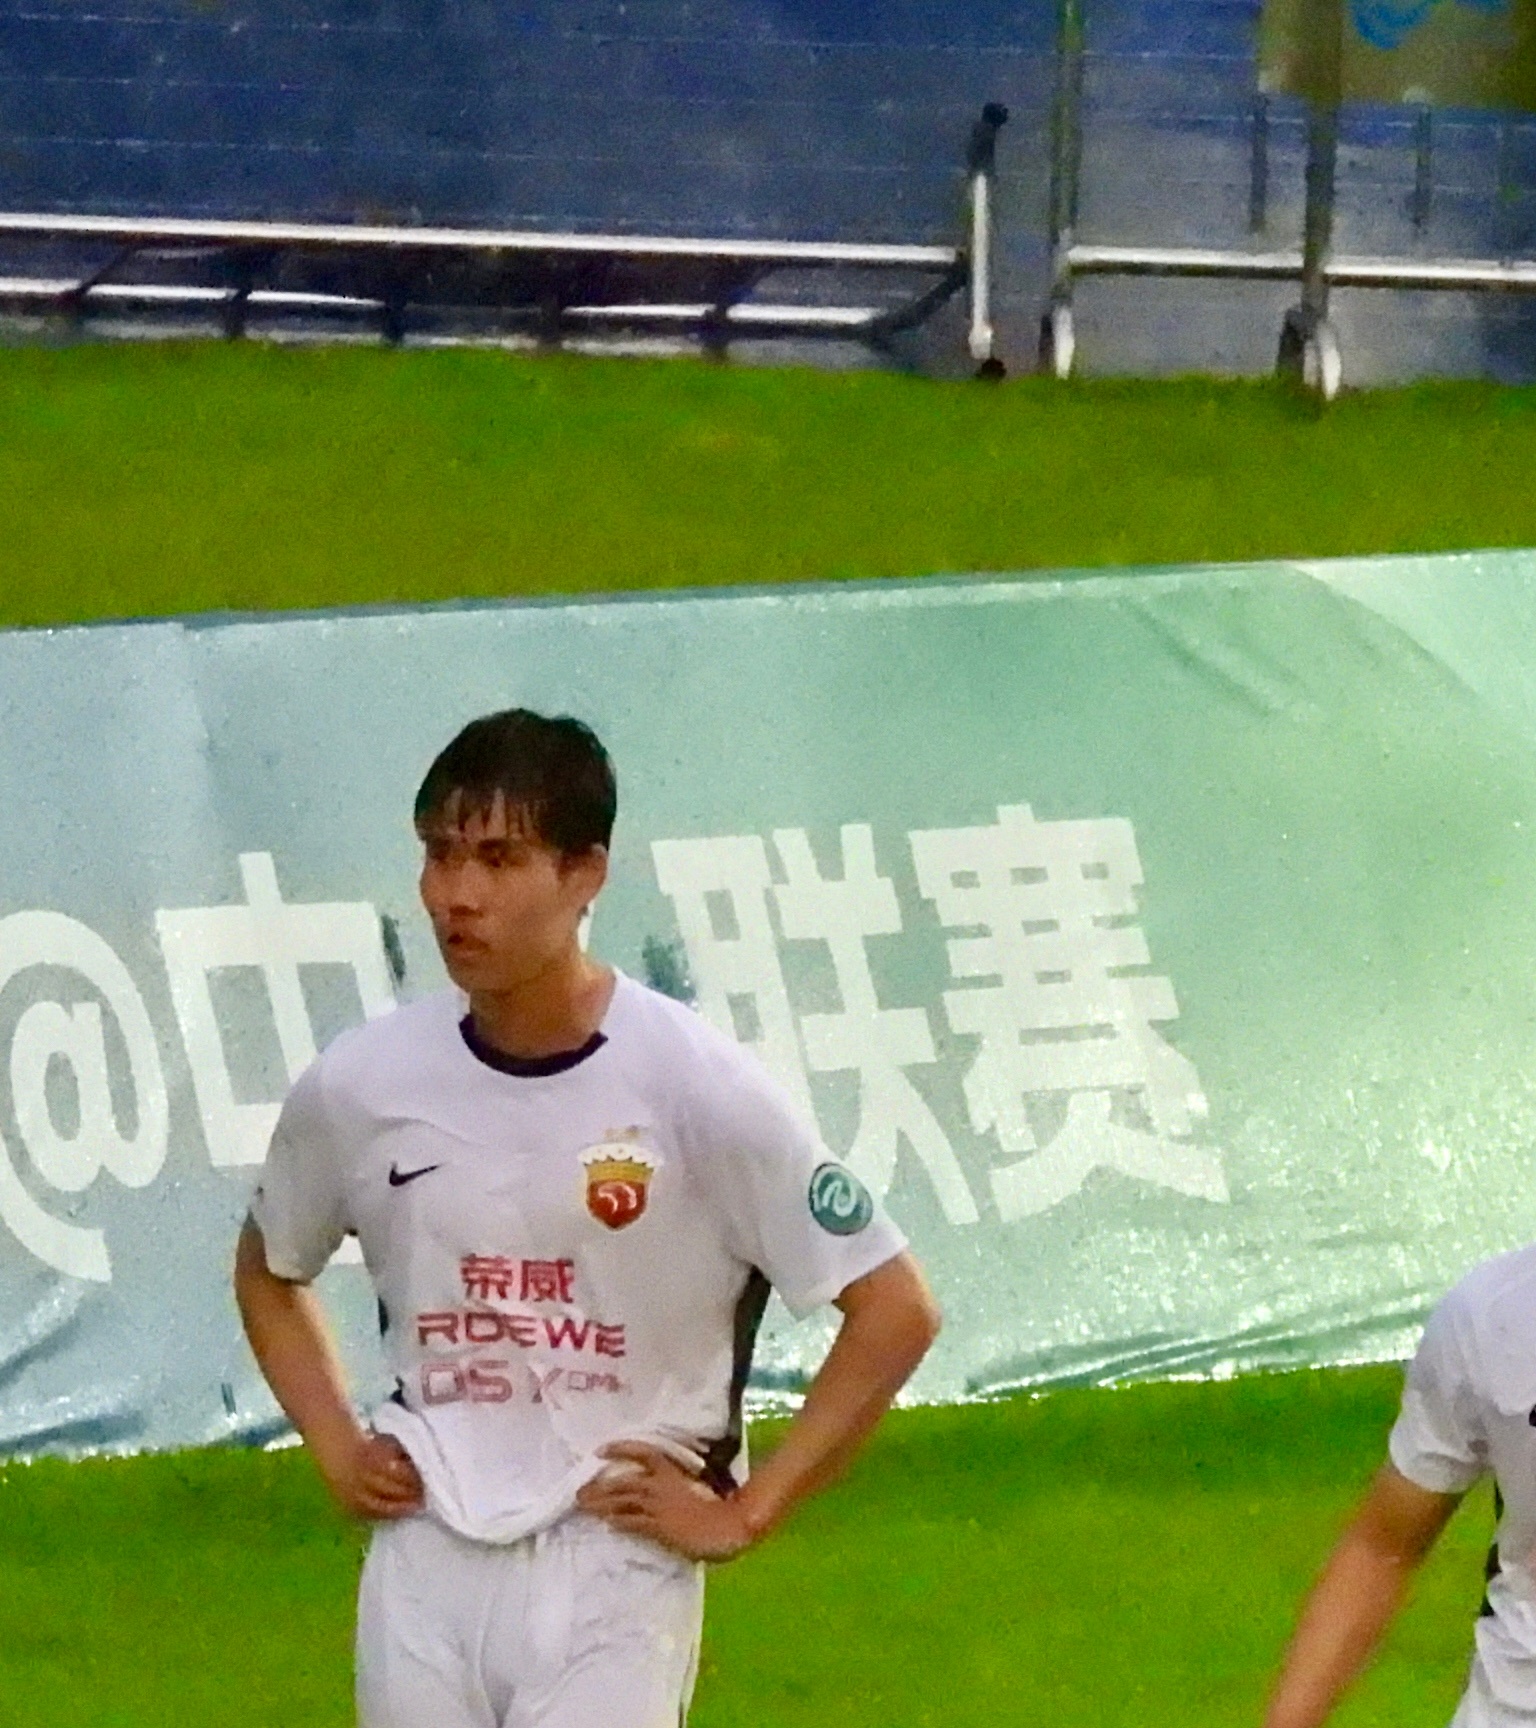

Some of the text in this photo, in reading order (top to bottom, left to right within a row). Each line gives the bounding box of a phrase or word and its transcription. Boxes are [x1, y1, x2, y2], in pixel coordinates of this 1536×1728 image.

[0, 804, 1231, 1282] @中联赛
[460, 1252, 576, 1304] 荣威
[417, 1311, 626, 1359] ROEWE
